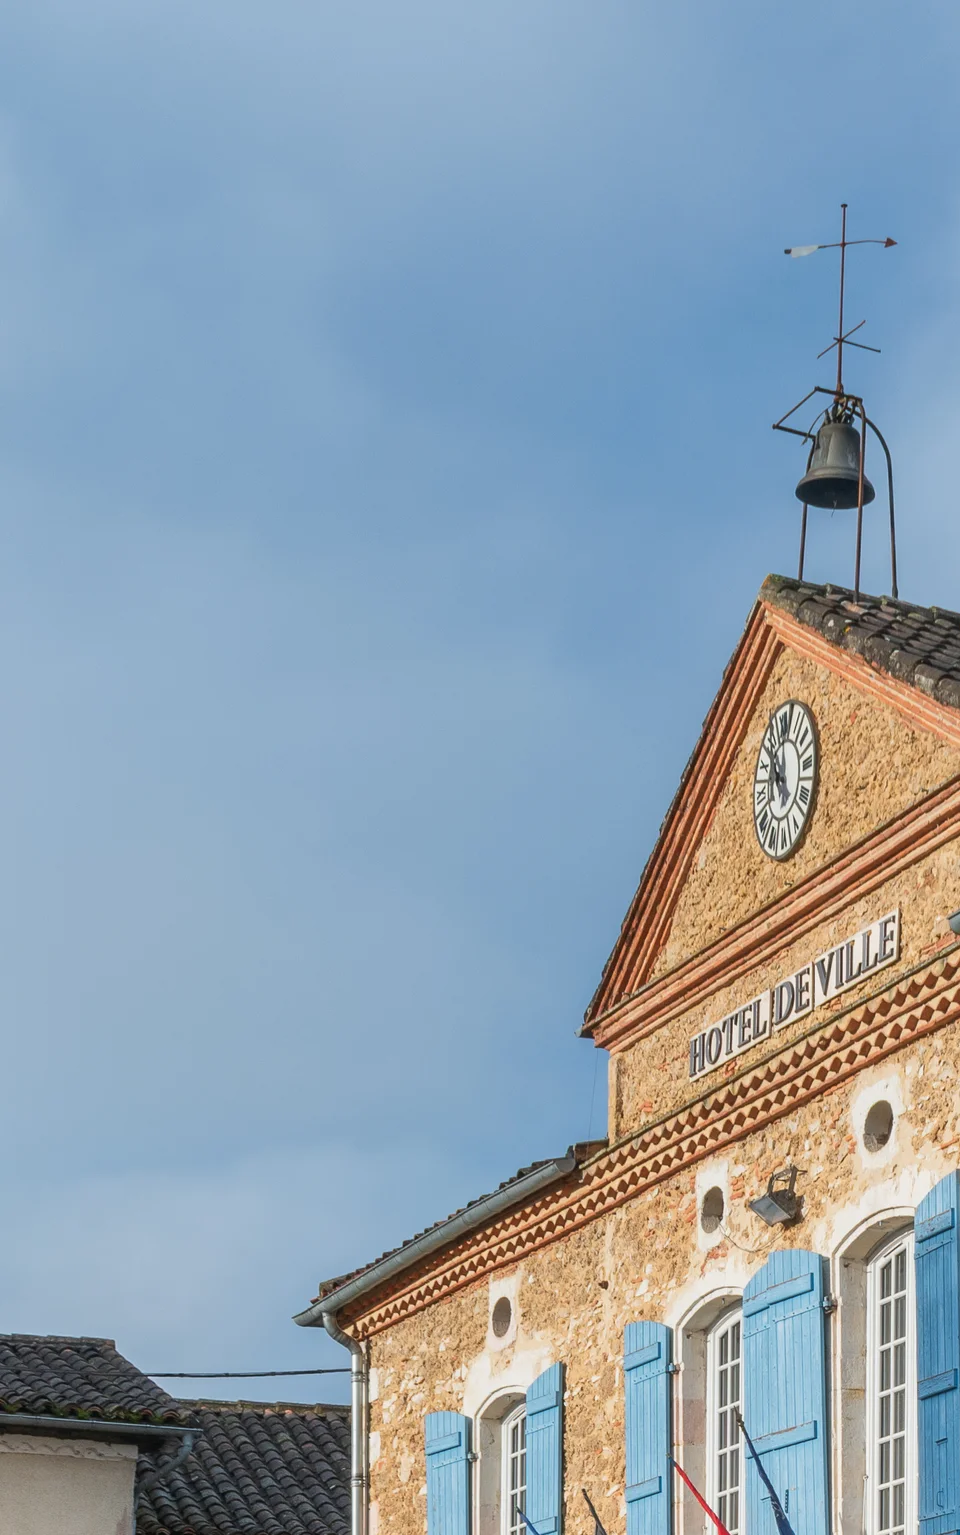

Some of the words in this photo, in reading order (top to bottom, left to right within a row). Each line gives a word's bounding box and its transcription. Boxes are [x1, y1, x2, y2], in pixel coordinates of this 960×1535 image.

[759, 759, 769, 773] X
[802, 754, 813, 771] III
[689, 999, 768, 1077] HOTEL
[773, 967, 810, 1025] DE
[814, 915, 897, 997] VILLE
